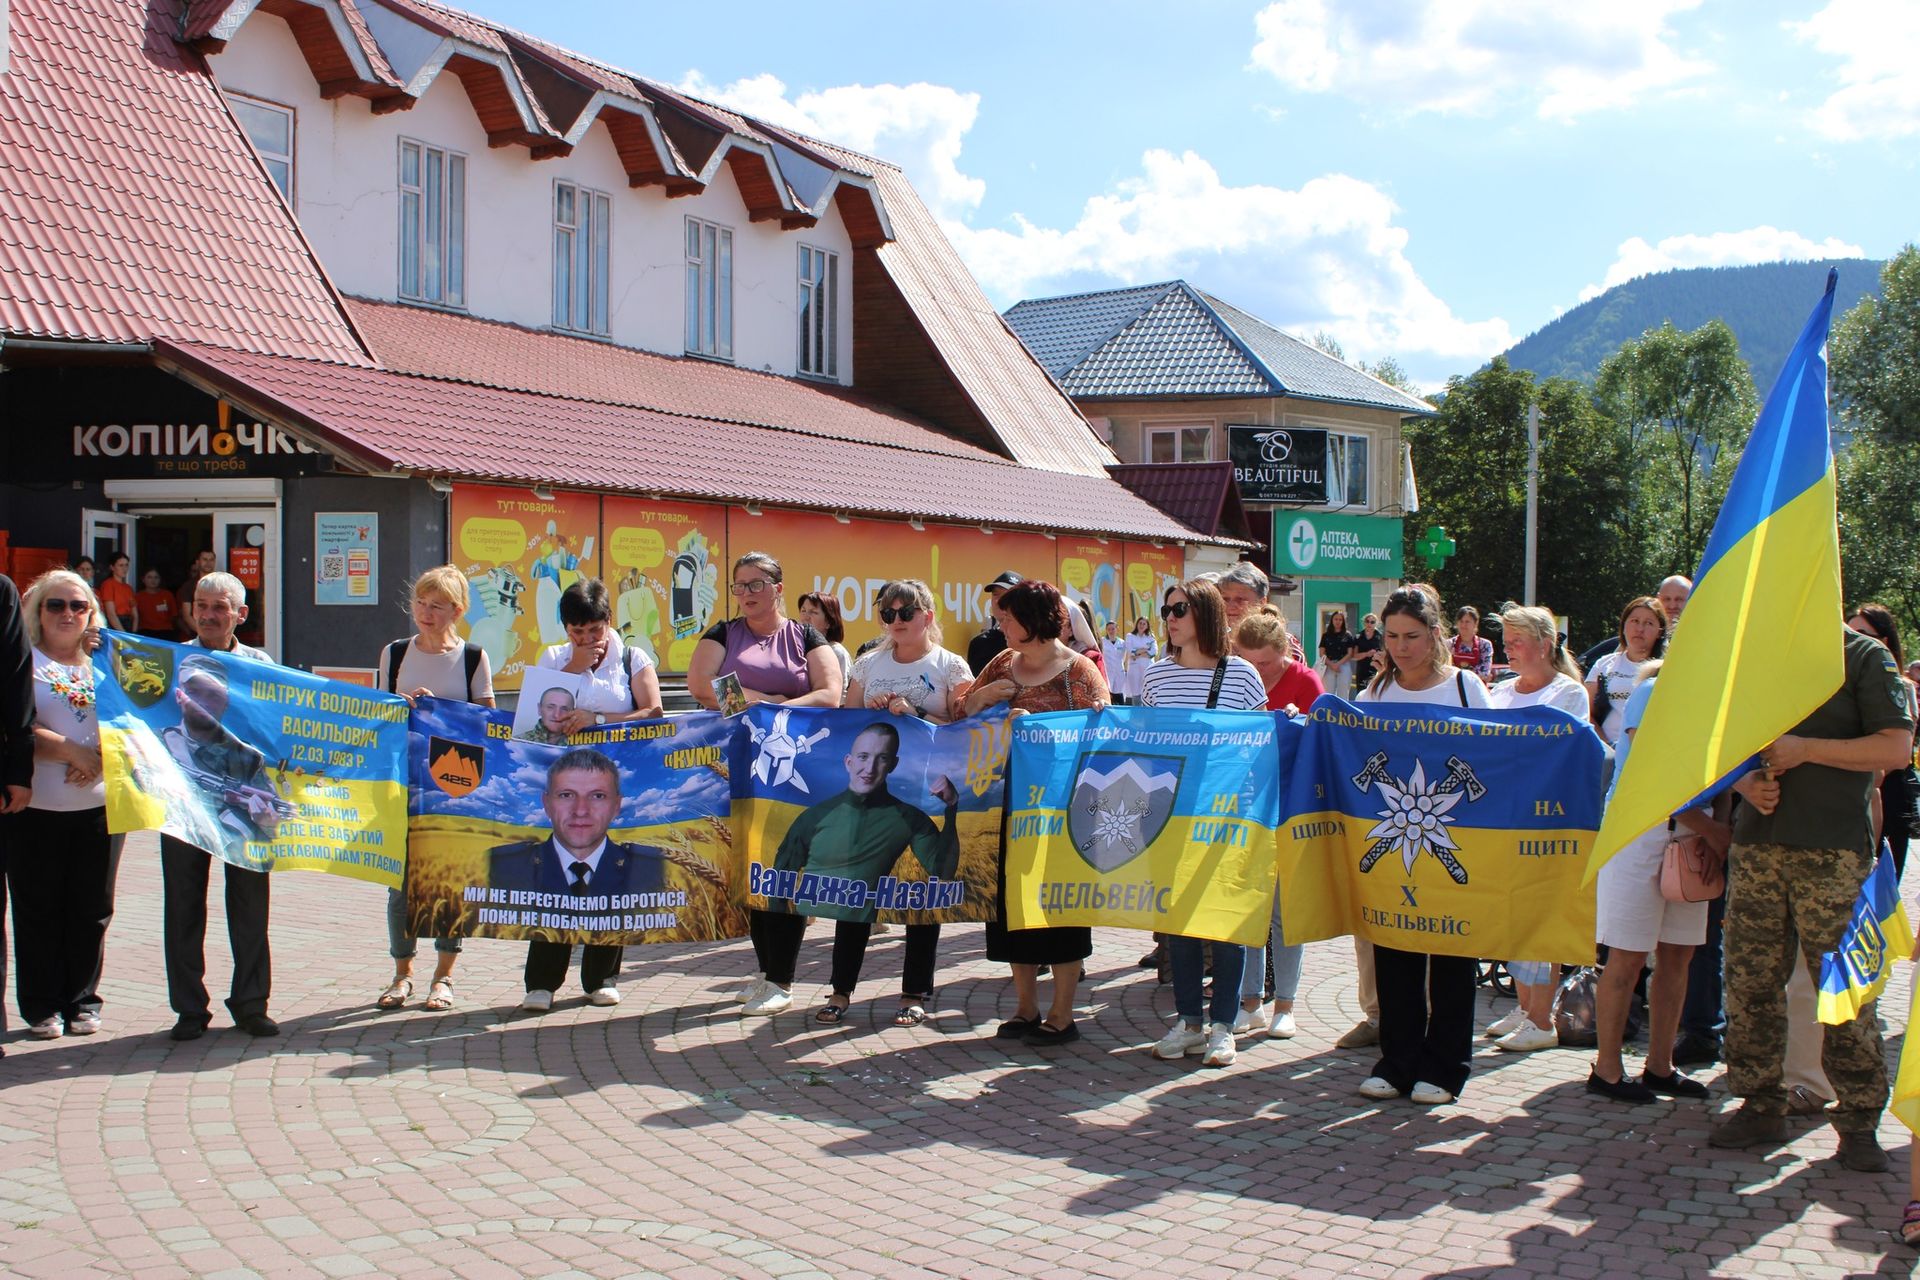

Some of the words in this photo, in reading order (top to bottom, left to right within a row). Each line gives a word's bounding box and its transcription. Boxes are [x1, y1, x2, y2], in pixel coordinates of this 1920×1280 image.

[158, 460, 173, 470] те
[178, 460, 199, 472] що
[204, 456, 246, 473] треба
[1234, 467, 1322, 484] BEAUTIFUL
[497, 500, 515, 514] тут
[517, 501, 565, 516] товари...
[640, 511, 656, 523] тут
[1320, 530, 1360, 545] АПТЕКА
[1320, 544, 1392, 560] ПОДОРОЖНИК
[252, 680, 317, 708] ШАТРУК
[320, 692, 409, 724] ВОЛОДИМИР
[282, 715, 378, 749] ВАСИЛЬОВИЧ
[610, 729, 626, 742] НЕ
[630, 723, 676, 741] ЗАБУТІ
[1030, 728, 1078, 744] ОКРЕМА
[1081, 726, 1208, 746] ГІРСЬКО-ШТУРМОВА
[1212, 730, 1272, 748] БРИГАДА
[1480, 721, 1575, 739] БРИГАДА
[664, 746, 720, 770] «КУМ»
[439, 772, 472, 788] 425
[1027, 785, 1046, 806] ЗІ
[1314, 784, 1324, 799] ЗІ
[1211, 794, 1240, 815] НА
[1535, 800, 1565, 816] НА
[280, 823, 306, 837] АЛЕ
[310, 824, 325, 838] НЕ
[328, 826, 384, 847] ЗАБУТИЙ
[1192, 822, 1248, 848] ЩИТІ
[1518, 839, 1579, 858] ЩИТІ
[464, 886, 487, 902] МИ
[490, 888, 506, 904] НЕ
[510, 890, 608, 912] ПЕРЕСТАНЕМО
[1038, 880, 1172, 914] ЕДЕЛЬВЕЙС
[478, 908, 518, 926] ПОКИ
[520, 910, 538, 926] НЕ
[541, 912, 620, 932] ПОБАЧИМО
[624, 912, 676, 932] ВДОМА
[1362, 906, 1472, 937] ЕДЕЛЬВЕЙС
